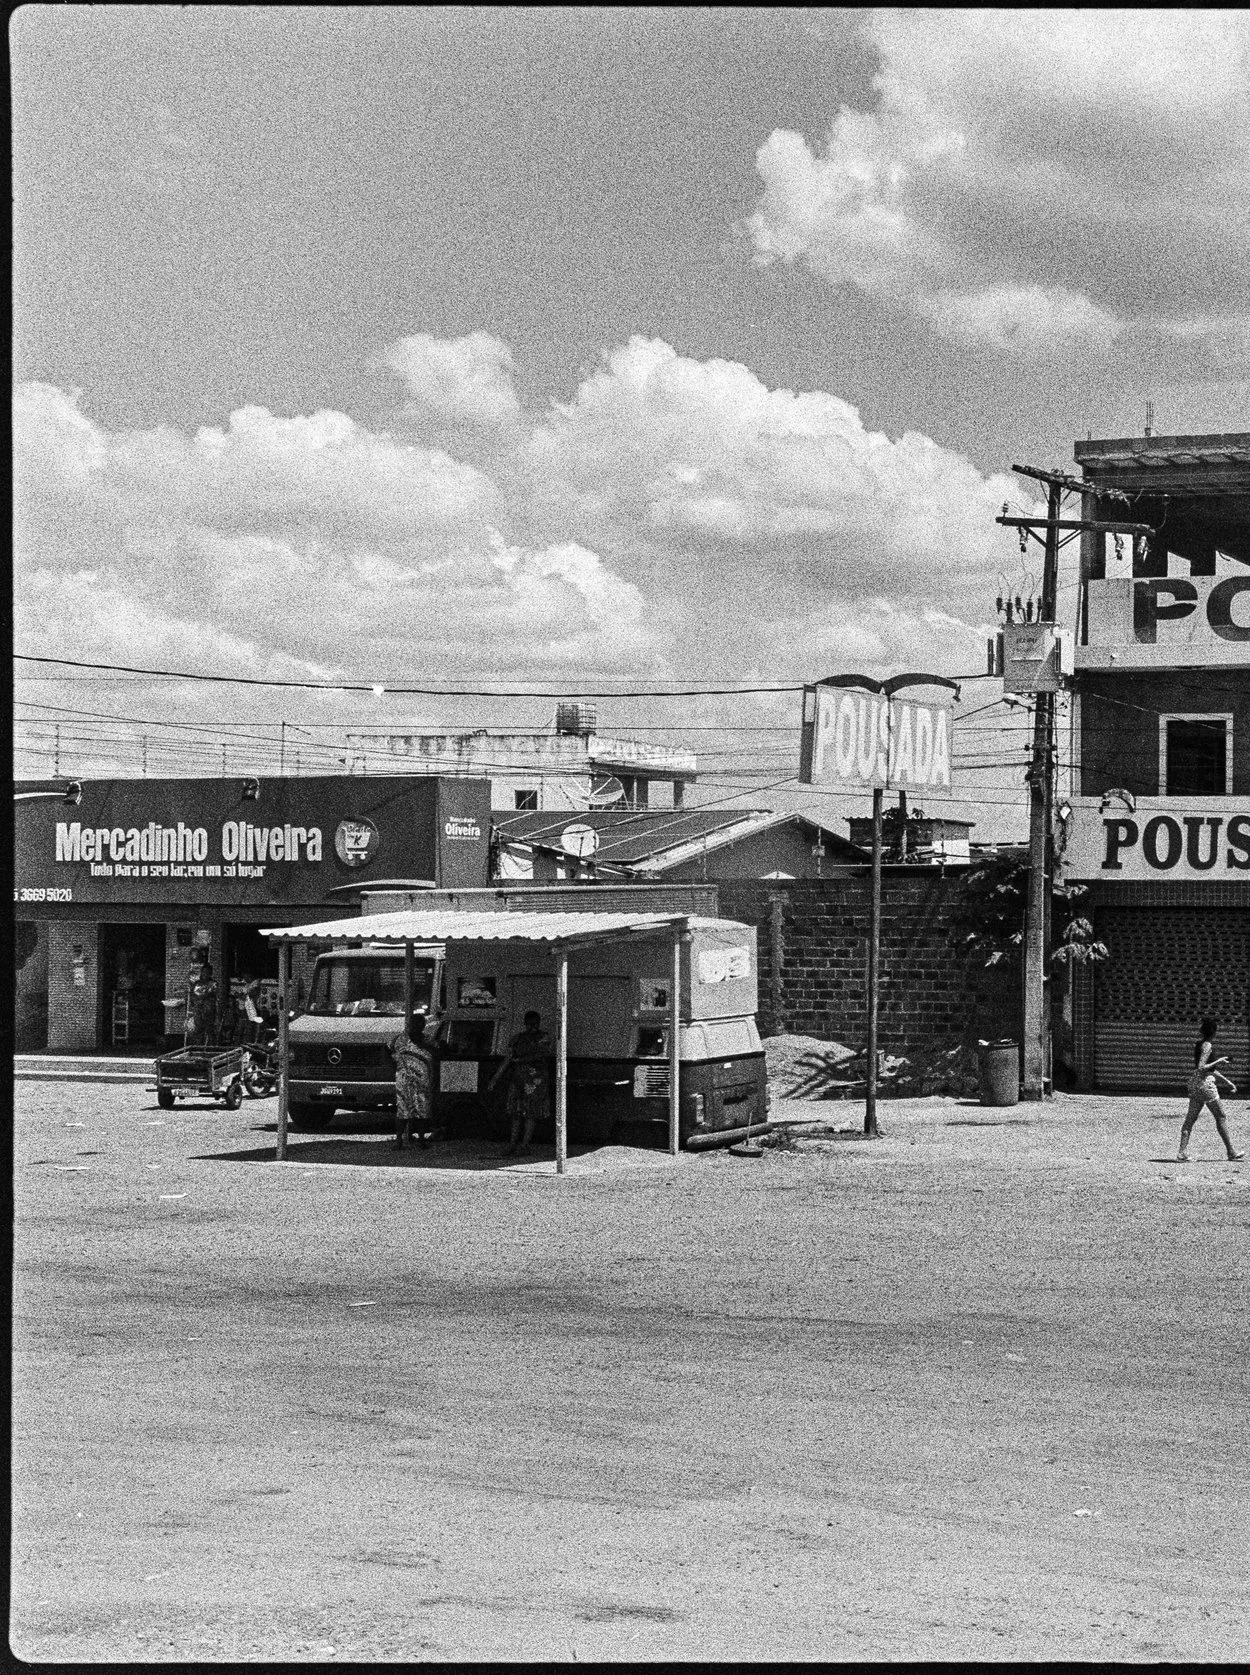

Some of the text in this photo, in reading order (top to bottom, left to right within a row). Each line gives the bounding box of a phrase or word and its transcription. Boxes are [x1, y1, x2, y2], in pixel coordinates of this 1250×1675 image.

[816, 692, 950, 786] POUSADA
[55, 821, 323, 862] Mercadinho Oliveira
[445, 822, 481, 837] Oliveira
[115, 864, 140, 878] para
[150, 864, 169, 877] seu
[223, 862, 236, 877] só
